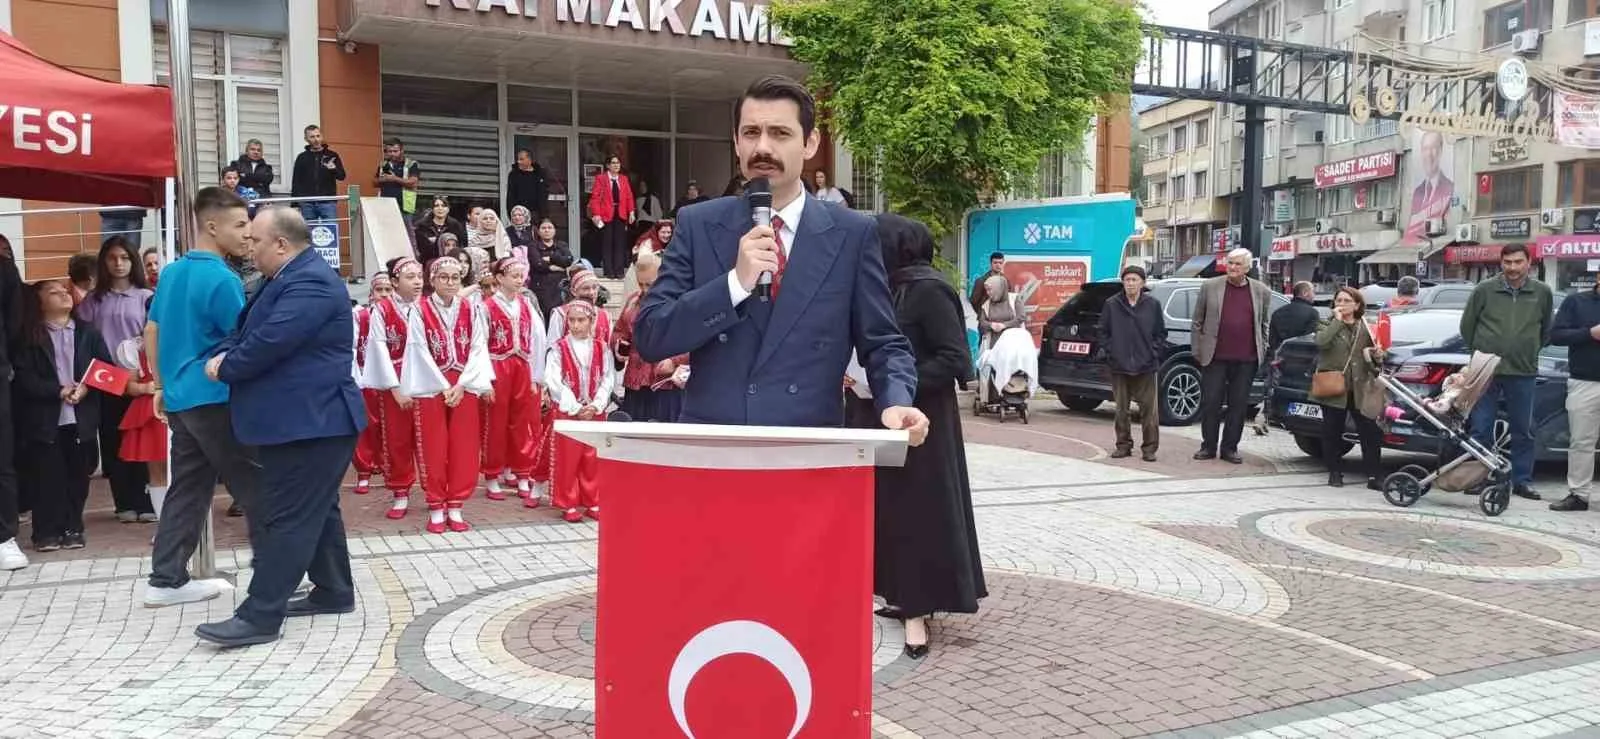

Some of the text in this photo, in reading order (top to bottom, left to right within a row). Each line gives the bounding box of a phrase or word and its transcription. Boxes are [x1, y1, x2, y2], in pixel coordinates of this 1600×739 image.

[425, 0, 797, 47] MAKAML
[1324, 160, 1356, 177] SAADET
[1042, 224, 1073, 239] TAM
[1272, 240, 1292, 252] CZANE
[1044, 265, 1081, 276] Bankkart
